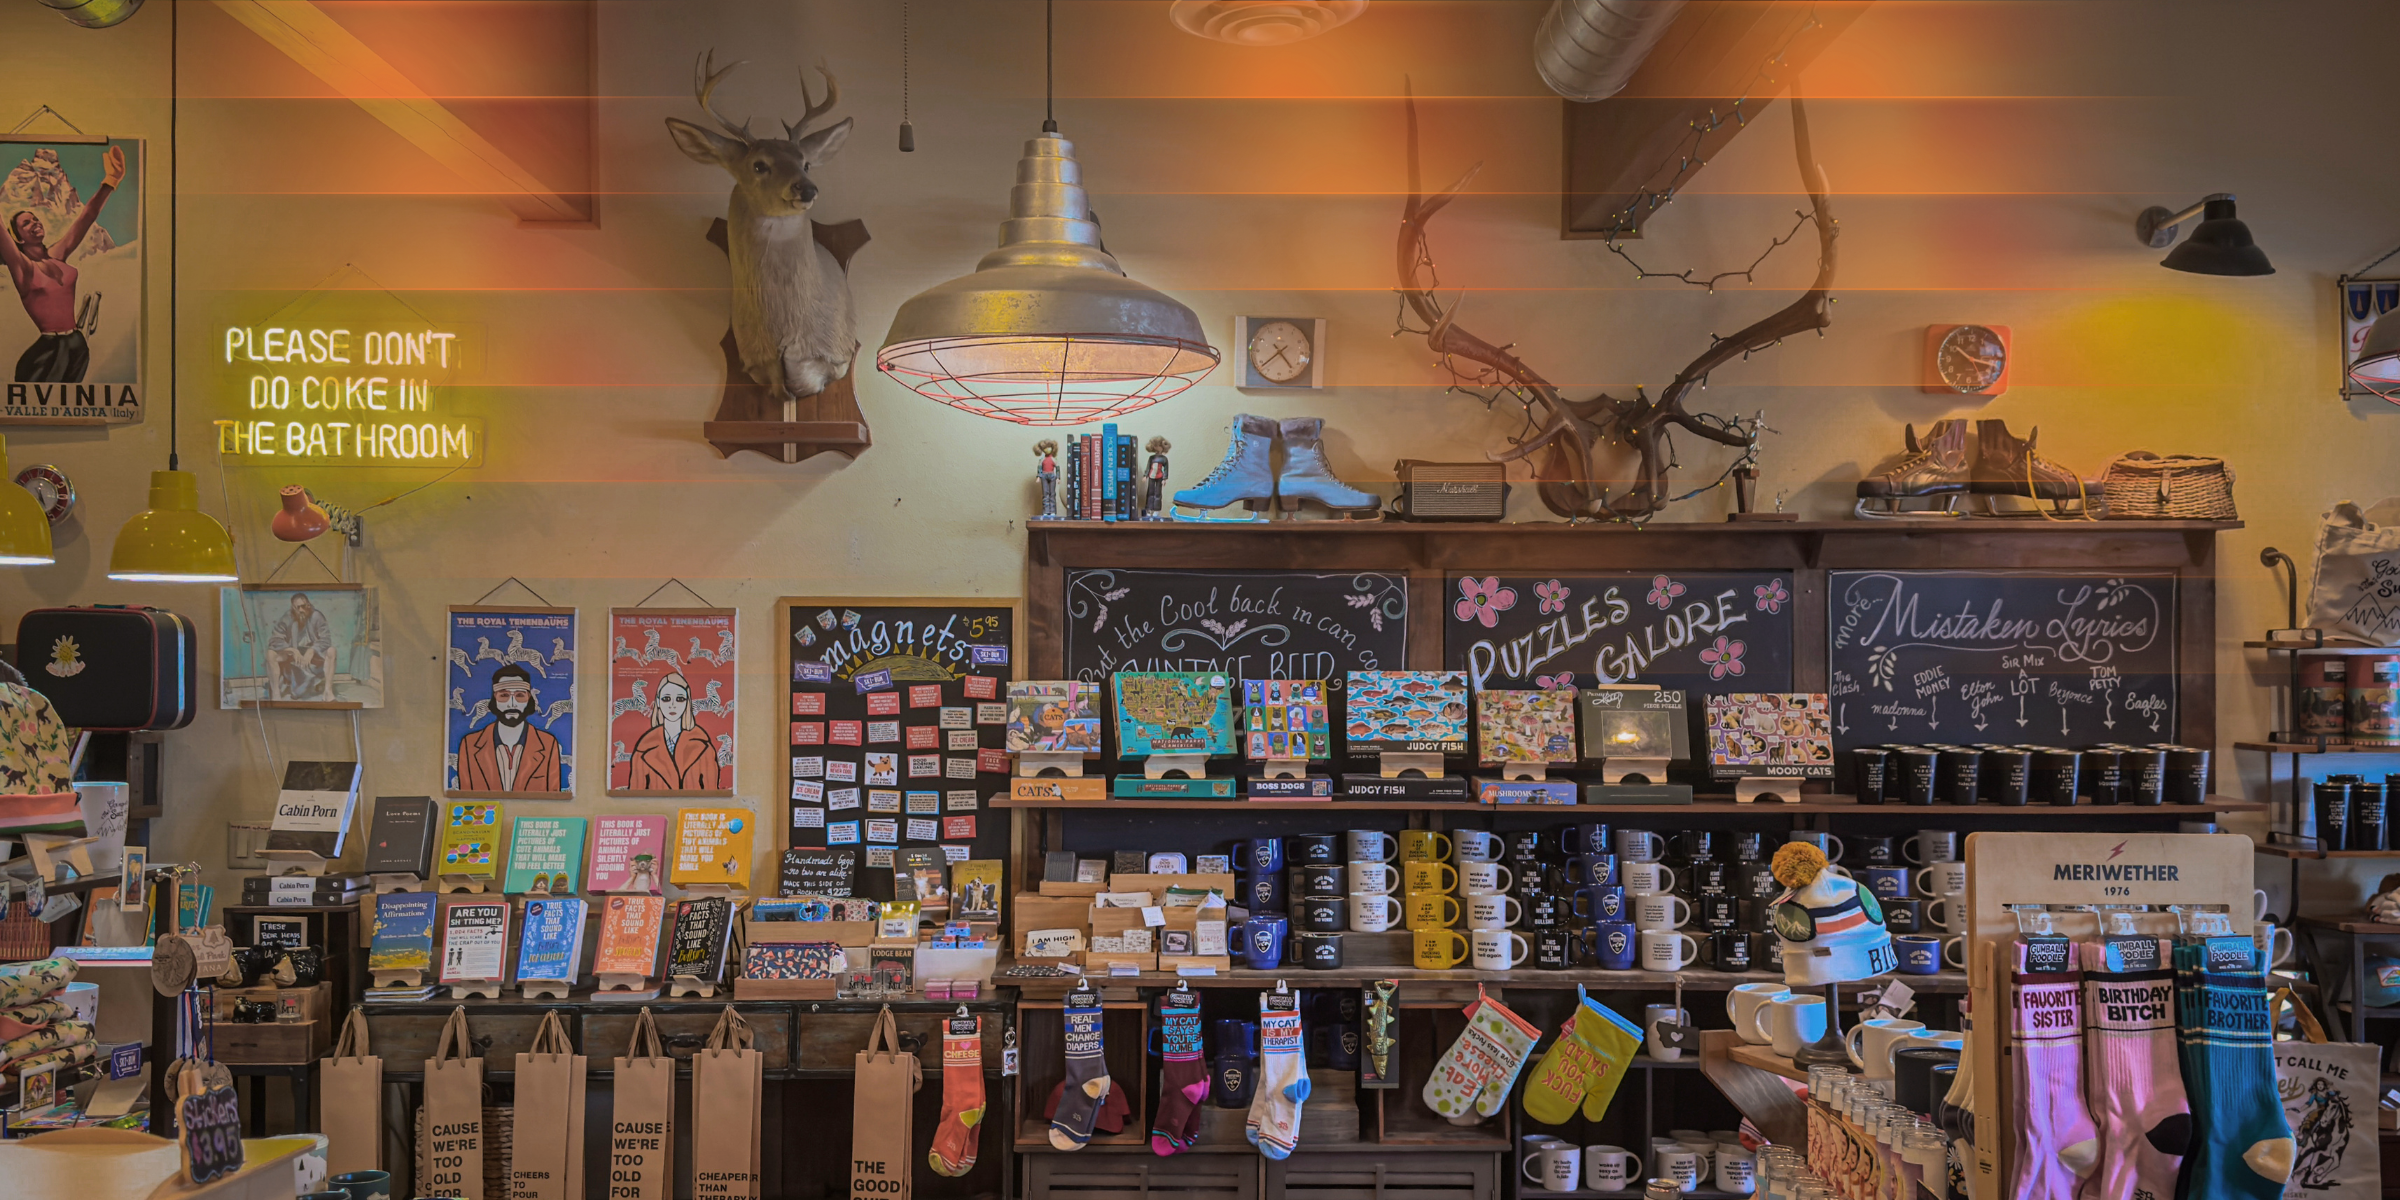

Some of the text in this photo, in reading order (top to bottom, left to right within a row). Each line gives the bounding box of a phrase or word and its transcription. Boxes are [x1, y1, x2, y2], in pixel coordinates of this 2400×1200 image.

[226, 327, 456, 368] PLEASE DON'T
[251, 376, 429, 411] DO COKE IN
[51, 407, 108, 417] D'AOSTA
[213, 420, 275, 454] THE
[457, 616, 569, 627] THE ROYAL TENENBAUMS
[619, 616, 730, 627] THE ROYAL TENENBAUMS
[1846, 575, 2040, 646] Mistaken
[2047, 585, 2148, 662] Lyrics
[1077, 645, 1117, 682] Put
[1115, 615, 1154, 649] the
[1160, 587, 1218, 626] Cool
[1230, 585, 1282, 616] back
[1293, 606, 1311, 624] in
[1318, 617, 1356, 651] can
[1595, 588, 1748, 684] GALORE
[1468, 586, 1630, 700] PUZZLES
[1834, 671, 1851, 682] The
[1914, 665, 1945, 686] EDDIE
[2018, 669, 2028, 679] A
[2090, 666, 2117, 679] TOM
[1832, 680, 1860, 696] Clash
[1915, 676, 1951, 699] MONEY
[2010, 678, 2040, 696] LOT
[2089, 676, 2122, 691] PETTY
[1960, 680, 1996, 700] Elton
[1654, 691, 1682, 703] 250
[1971, 692, 2004, 719] John
[2125, 692, 2168, 718] Eagles
[1044, 713, 1064, 721] CATS
[1406, 742, 1464, 751] JUDGY FISH
[1767, 767, 1832, 776] MOODY CATS
[1256, 782, 1305, 791] BOSS DOGS
[1348, 785, 1406, 795] JUDGY FISH
[1488, 790, 1533, 799] MUSHROOMS
[279, 804, 338, 818] Cabin Porn
[617, 820, 635, 828] BOOK
[636, 820, 642, 828] IS
[598, 846, 628, 854] ANIMALS
[595, 872, 608, 880] YOU
[2053, 864, 2179, 881] MERIWETHER
[2104, 887, 2130, 896] 1976
[381, 902, 428, 911] Disappointing
[693, 902, 710, 910] TRUE
[383, 910, 425, 918] Affirmations
[455, 908, 498, 917] ARE YOU
[690, 911, 709, 920] FACTS
[486, 917, 501, 925] ME?
[690, 920, 706, 929] THAT
[684, 929, 707, 940] SOUND
[687, 939, 702, 949] LIKE
[2030, 943, 2066, 955] GUMBALL
[2210, 942, 2250, 953] GUMBALL
[2030, 951, 2064, 963] POODLE
[2211, 951, 2249, 961] POODLE
[2023, 989, 2082, 1009] FAVORITE
[2100, 986, 2172, 1004] BIRTHDAY
[2205, 991, 2269, 1010] FAVORITE
[2108, 1004, 2166, 1021] BITCH
[1071, 1015, 1095, 1024] REAL
[1165, 1017, 1198, 1026] MY CAT
[1263, 1020, 1297, 1029] MY CAT
[2033, 1010, 2073, 1028] SISTER
[2207, 1011, 2269, 1030] BROTHER
[1074, 1024, 1092, 1032] MEN
[1169, 1026, 1194, 1034] SAYS
[1266, 1028, 1294, 1037] IS MY
[1065, 1032, 1100, 1041] CHANGE
[1166, 1034, 1199, 1043] YOU'RE
[1264, 1037, 1298, 1045] THERAPIST
[1066, 1042, 1099, 1051] DIAPERS
[1170, 1043, 1193, 1052] DUMB
[1487, 1043, 1501, 1058] less
[944, 1050, 980, 1058] CHEESE
[1500, 1052, 1515, 1068] Give
[1455, 1051, 1490, 1085] More
[2287, 1056, 2349, 1080] CALL ME
[1446, 1066, 1477, 1098] Eat
[1542, 1069, 1582, 1104] FUCK
[184, 1096, 239, 1130] Stickers
[432, 1122, 479, 1136] CAUSE
[614, 1122, 663, 1134] CAUSE
[433, 1139, 477, 1152] WE'RE
[614, 1138, 659, 1150] WE'RE
[433, 1156, 463, 1168] TOO
[613, 1154, 644, 1166] TOO
[854, 1160, 886, 1174] THE
[434, 1173, 462, 1185] OLD
[513, 1171, 550, 1179] CHEERS
[612, 1170, 641, 1182] OLD
[699, 1172, 748, 1181] CHEAPER
[513, 1181, 526, 1189] TO
[699, 1183, 728, 1192] THAN
[853, 1179, 900, 1193] GOOD
[434, 1189, 462, 1198] FOR
[513, 1191, 538, 1199] POUR
[611, 1187, 640, 1198] FOR
